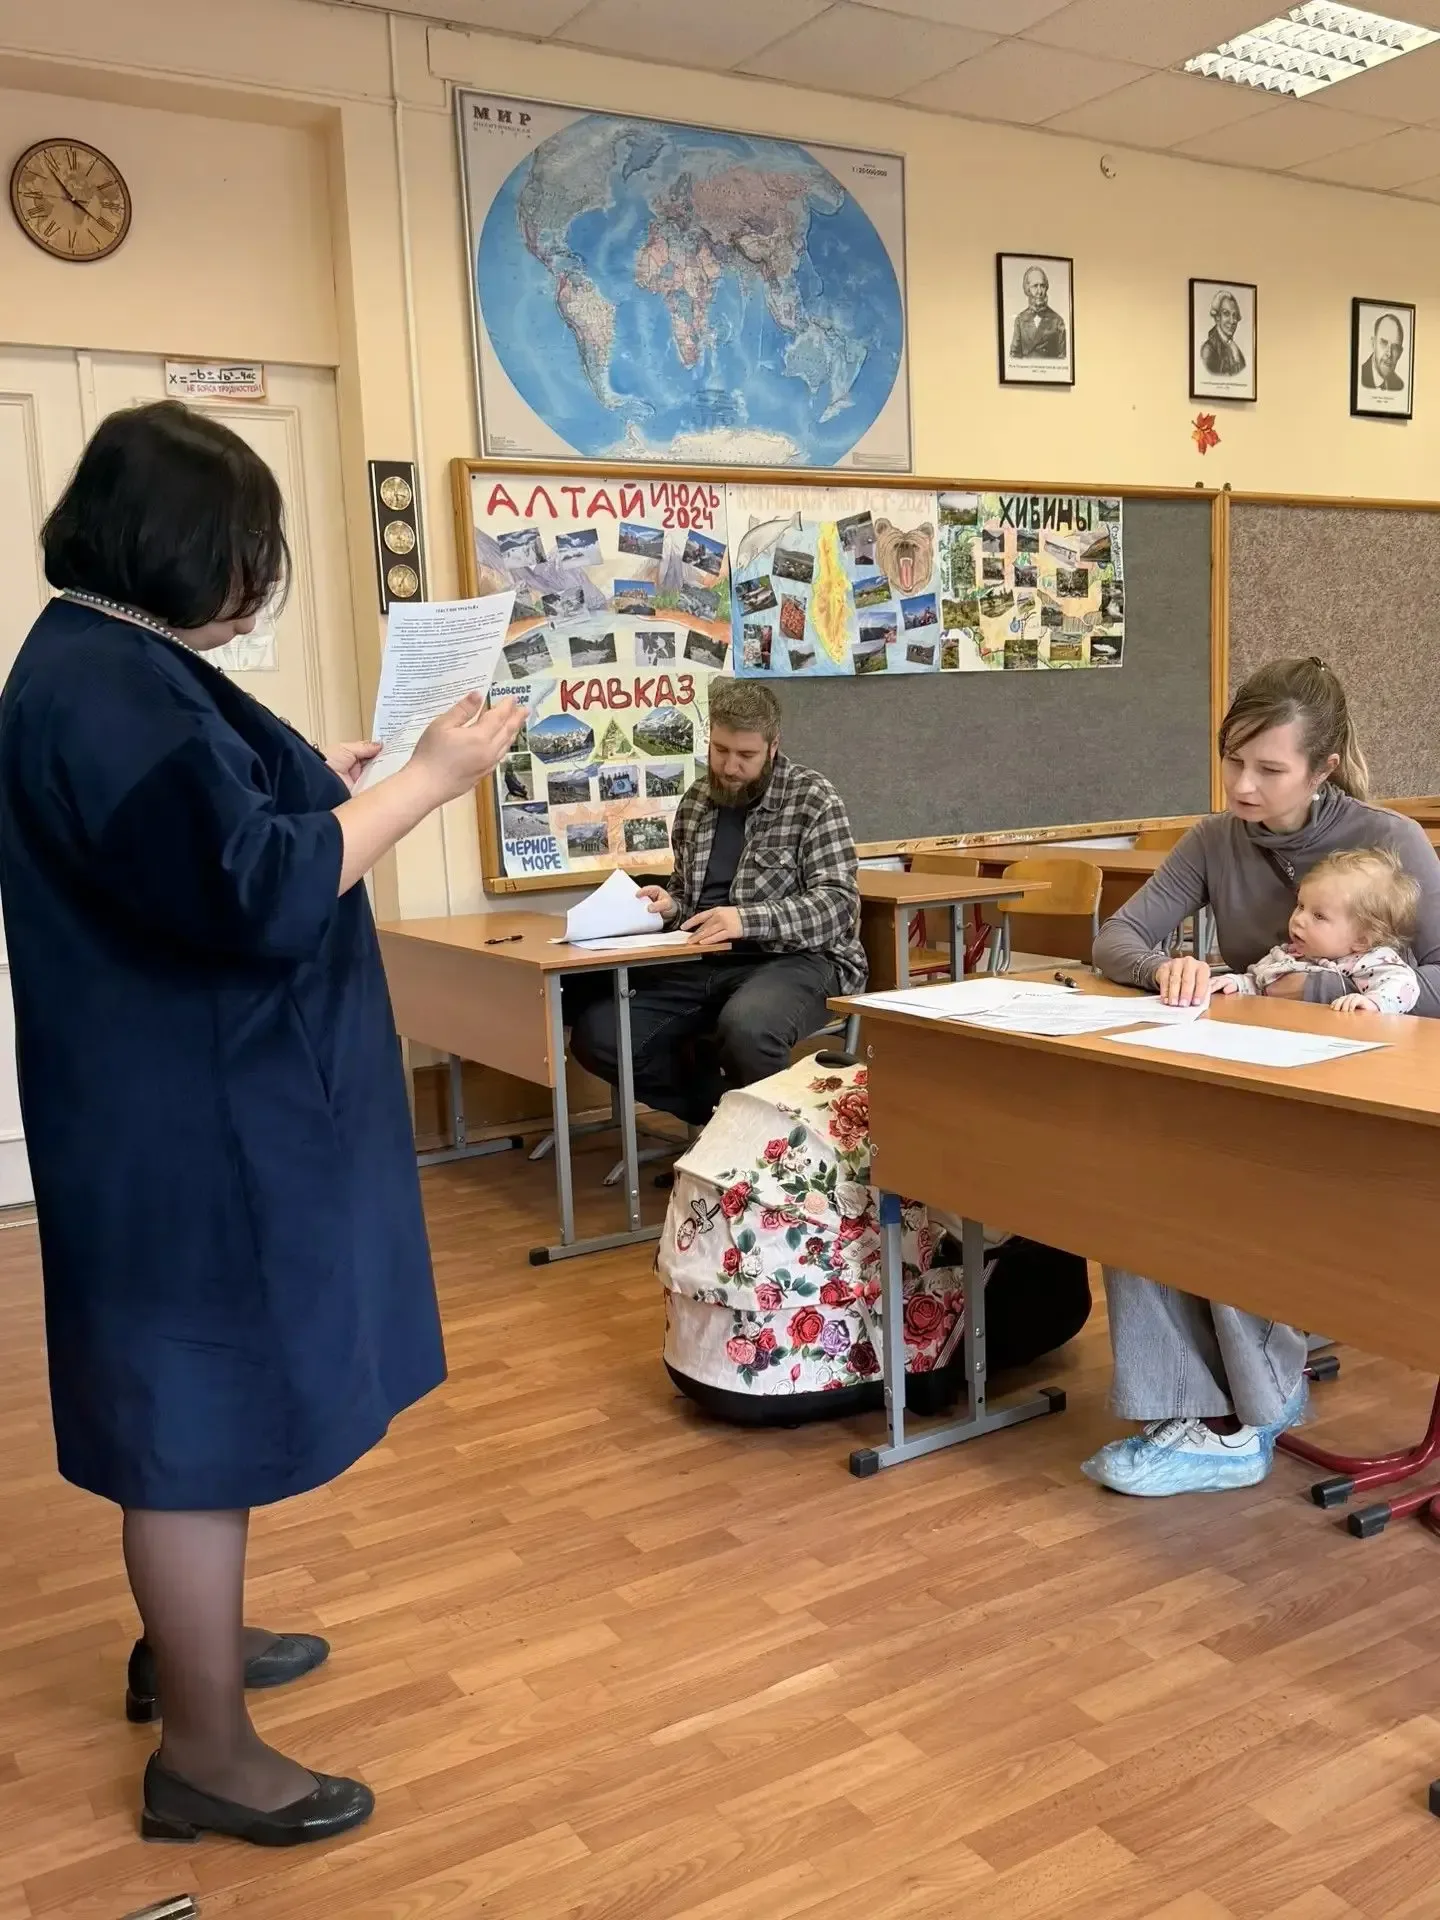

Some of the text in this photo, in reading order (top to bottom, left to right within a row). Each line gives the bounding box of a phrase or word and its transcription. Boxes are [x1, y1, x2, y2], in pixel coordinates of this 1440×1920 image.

[472, 105, 532, 126] МИР
[487, 482, 646, 520] АЛТАЙ
[649, 482, 721, 509] ИЮЛЬ
[661, 507, 715, 531] 2024
[999, 495, 1092, 532] ХИБИНЫ
[560, 674, 696, 713] КАВКАЗ
[521, 853, 562, 872] МОРЕ
